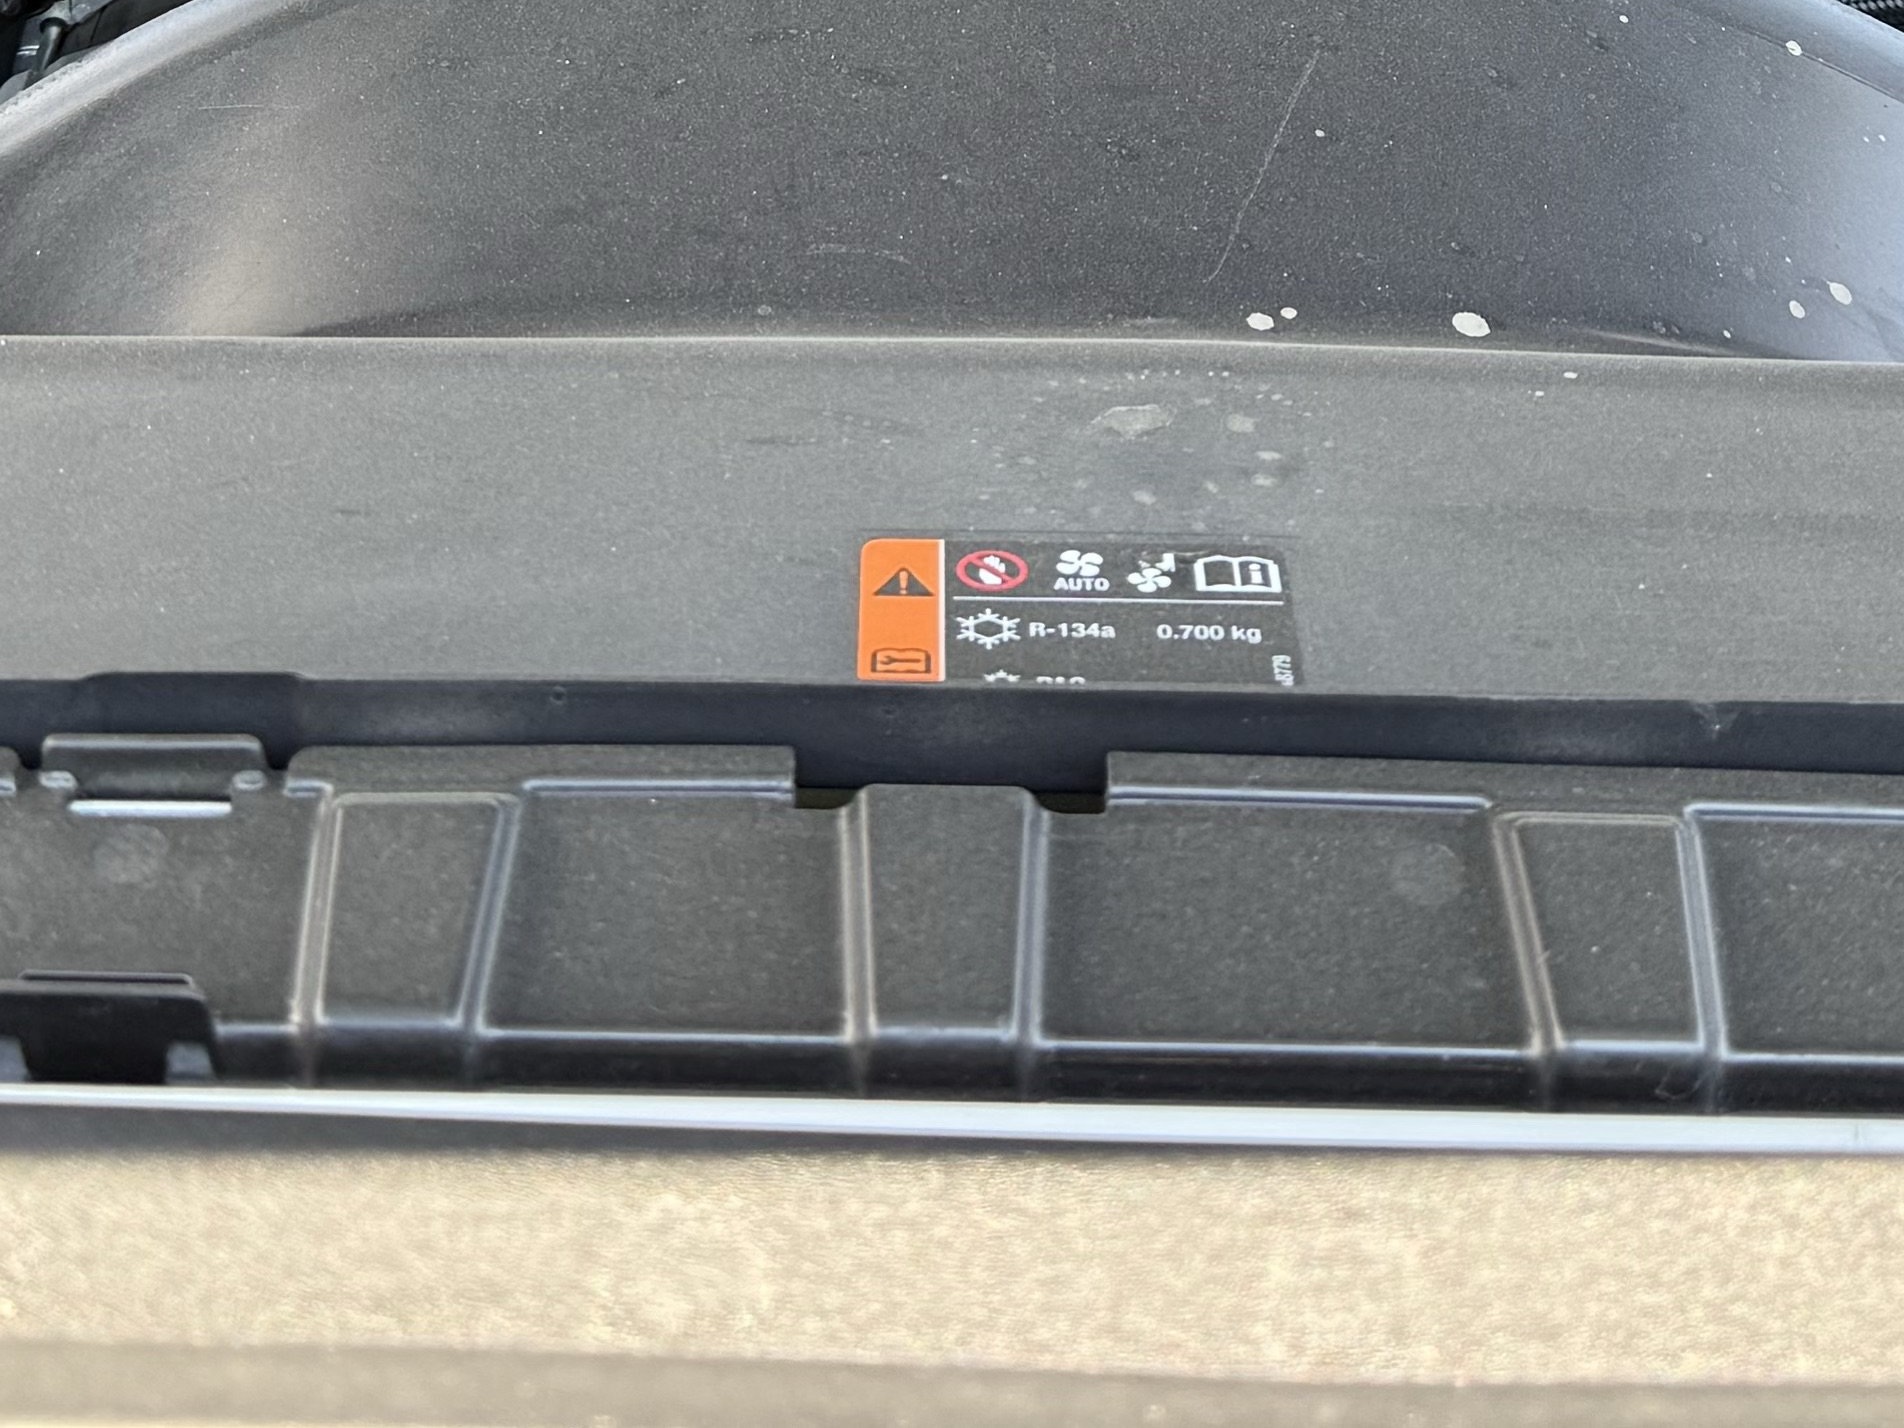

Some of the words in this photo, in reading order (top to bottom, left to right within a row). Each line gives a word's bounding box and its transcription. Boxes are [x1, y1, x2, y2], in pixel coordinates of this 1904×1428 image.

[1053, 576, 1111, 592] AUTO
[1028, 621, 1116, 639] R-134a
[1156, 623, 1225, 641] 0.700
[1230, 624, 1263, 645] kg
